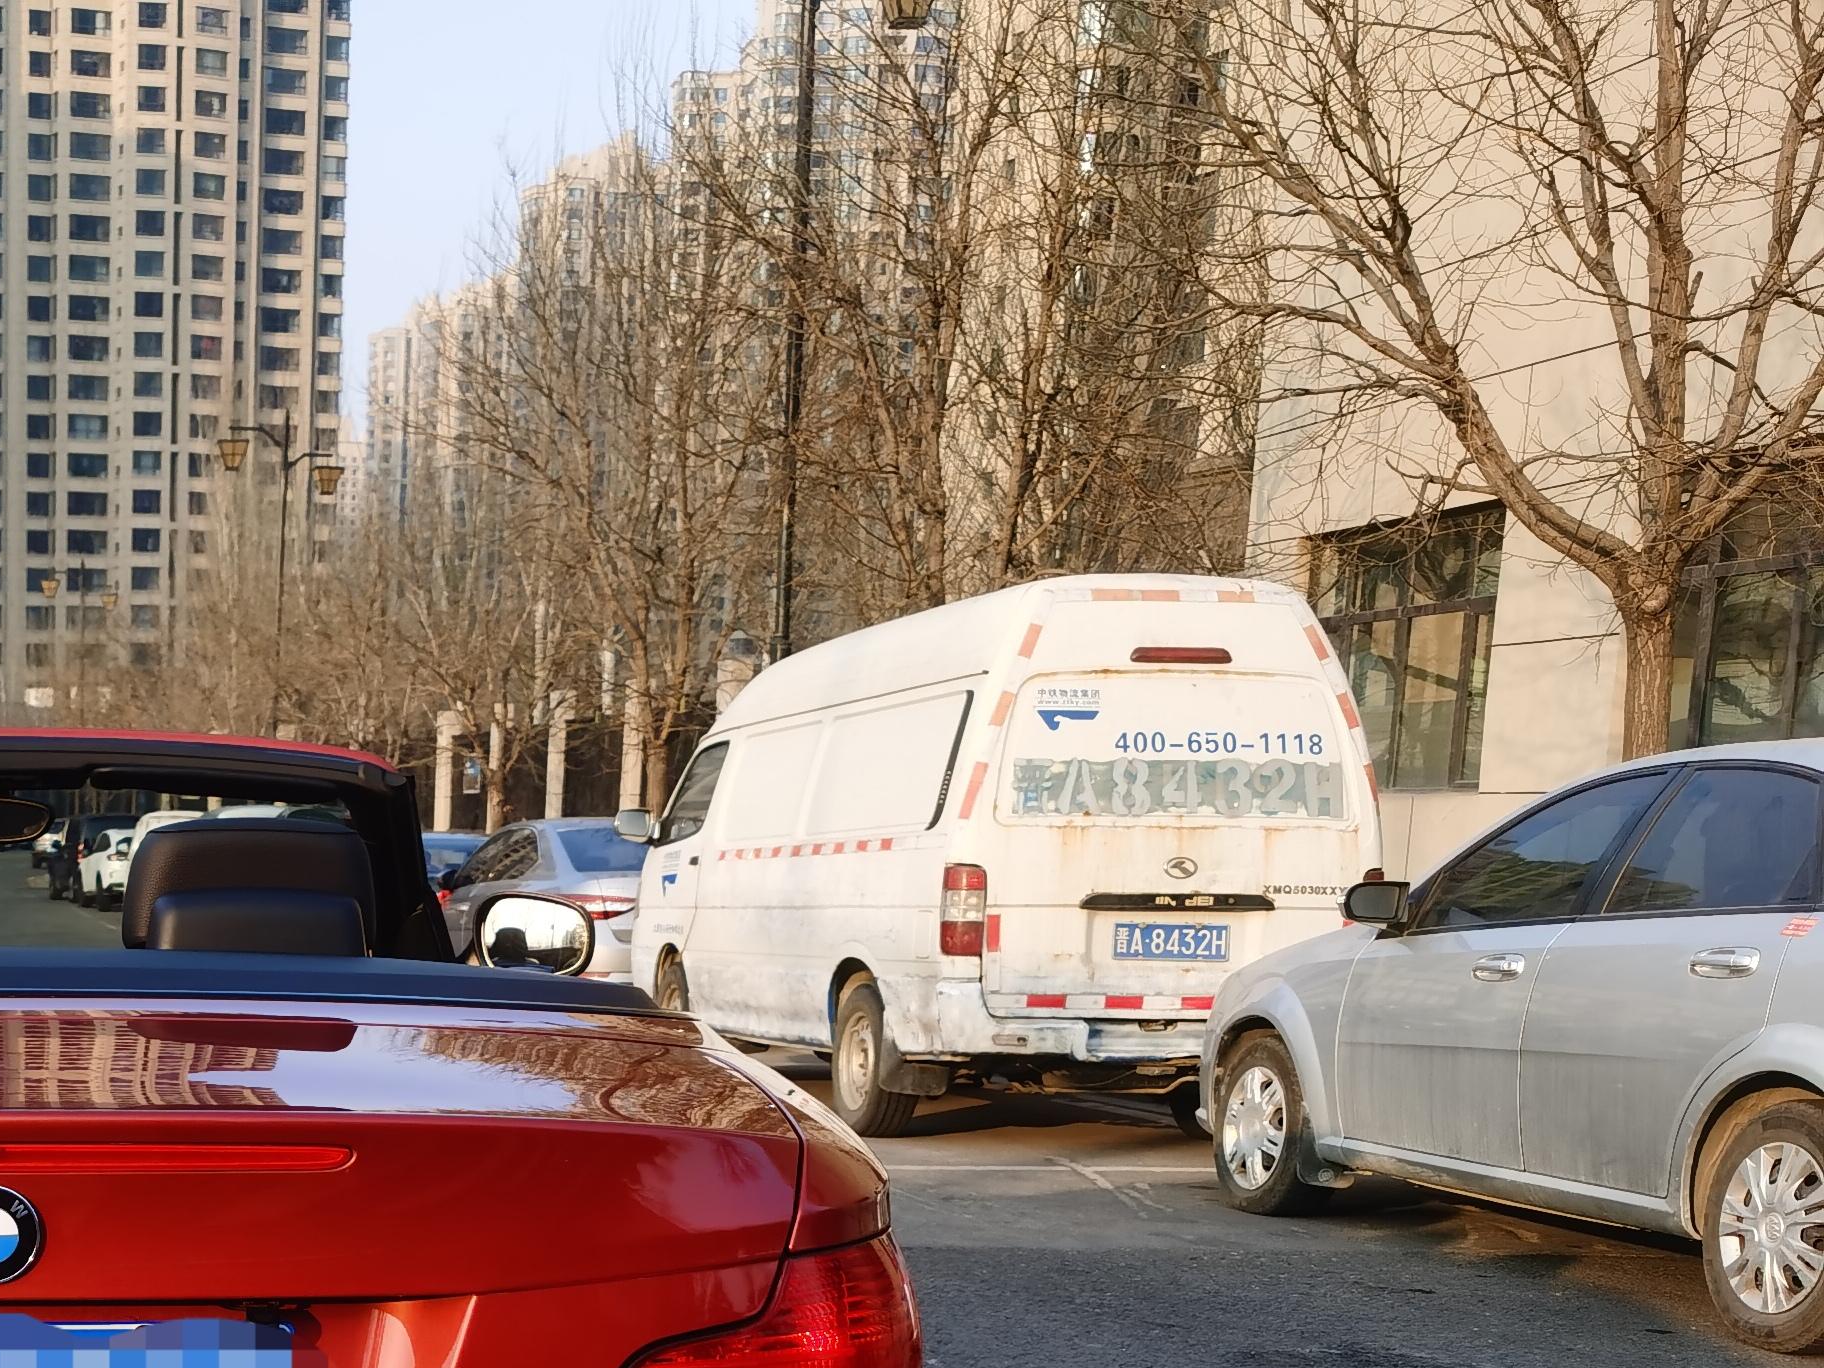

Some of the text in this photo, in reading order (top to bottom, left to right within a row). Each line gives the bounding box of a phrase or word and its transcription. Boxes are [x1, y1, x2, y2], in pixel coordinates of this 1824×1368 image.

[1037, 689, 1100, 699] 中铁物流集团
[1114, 731, 1323, 755] 400-650-1118
